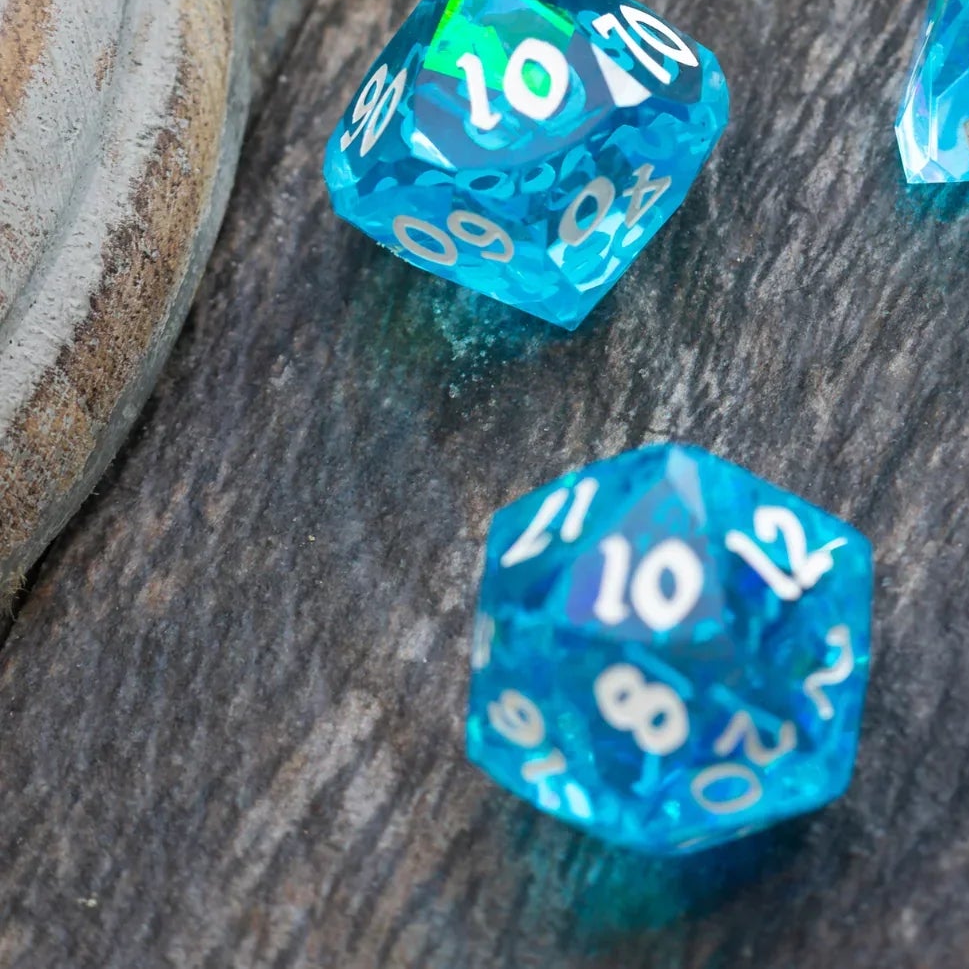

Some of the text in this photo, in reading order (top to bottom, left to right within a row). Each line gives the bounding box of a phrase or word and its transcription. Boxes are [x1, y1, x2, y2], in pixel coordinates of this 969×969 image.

[456, 37, 569, 130] 10
[592, 4, 699, 85] 70
[594, 533, 703, 631] 10
[725, 505, 838, 600] 12
[593, 663, 690, 755] 8
